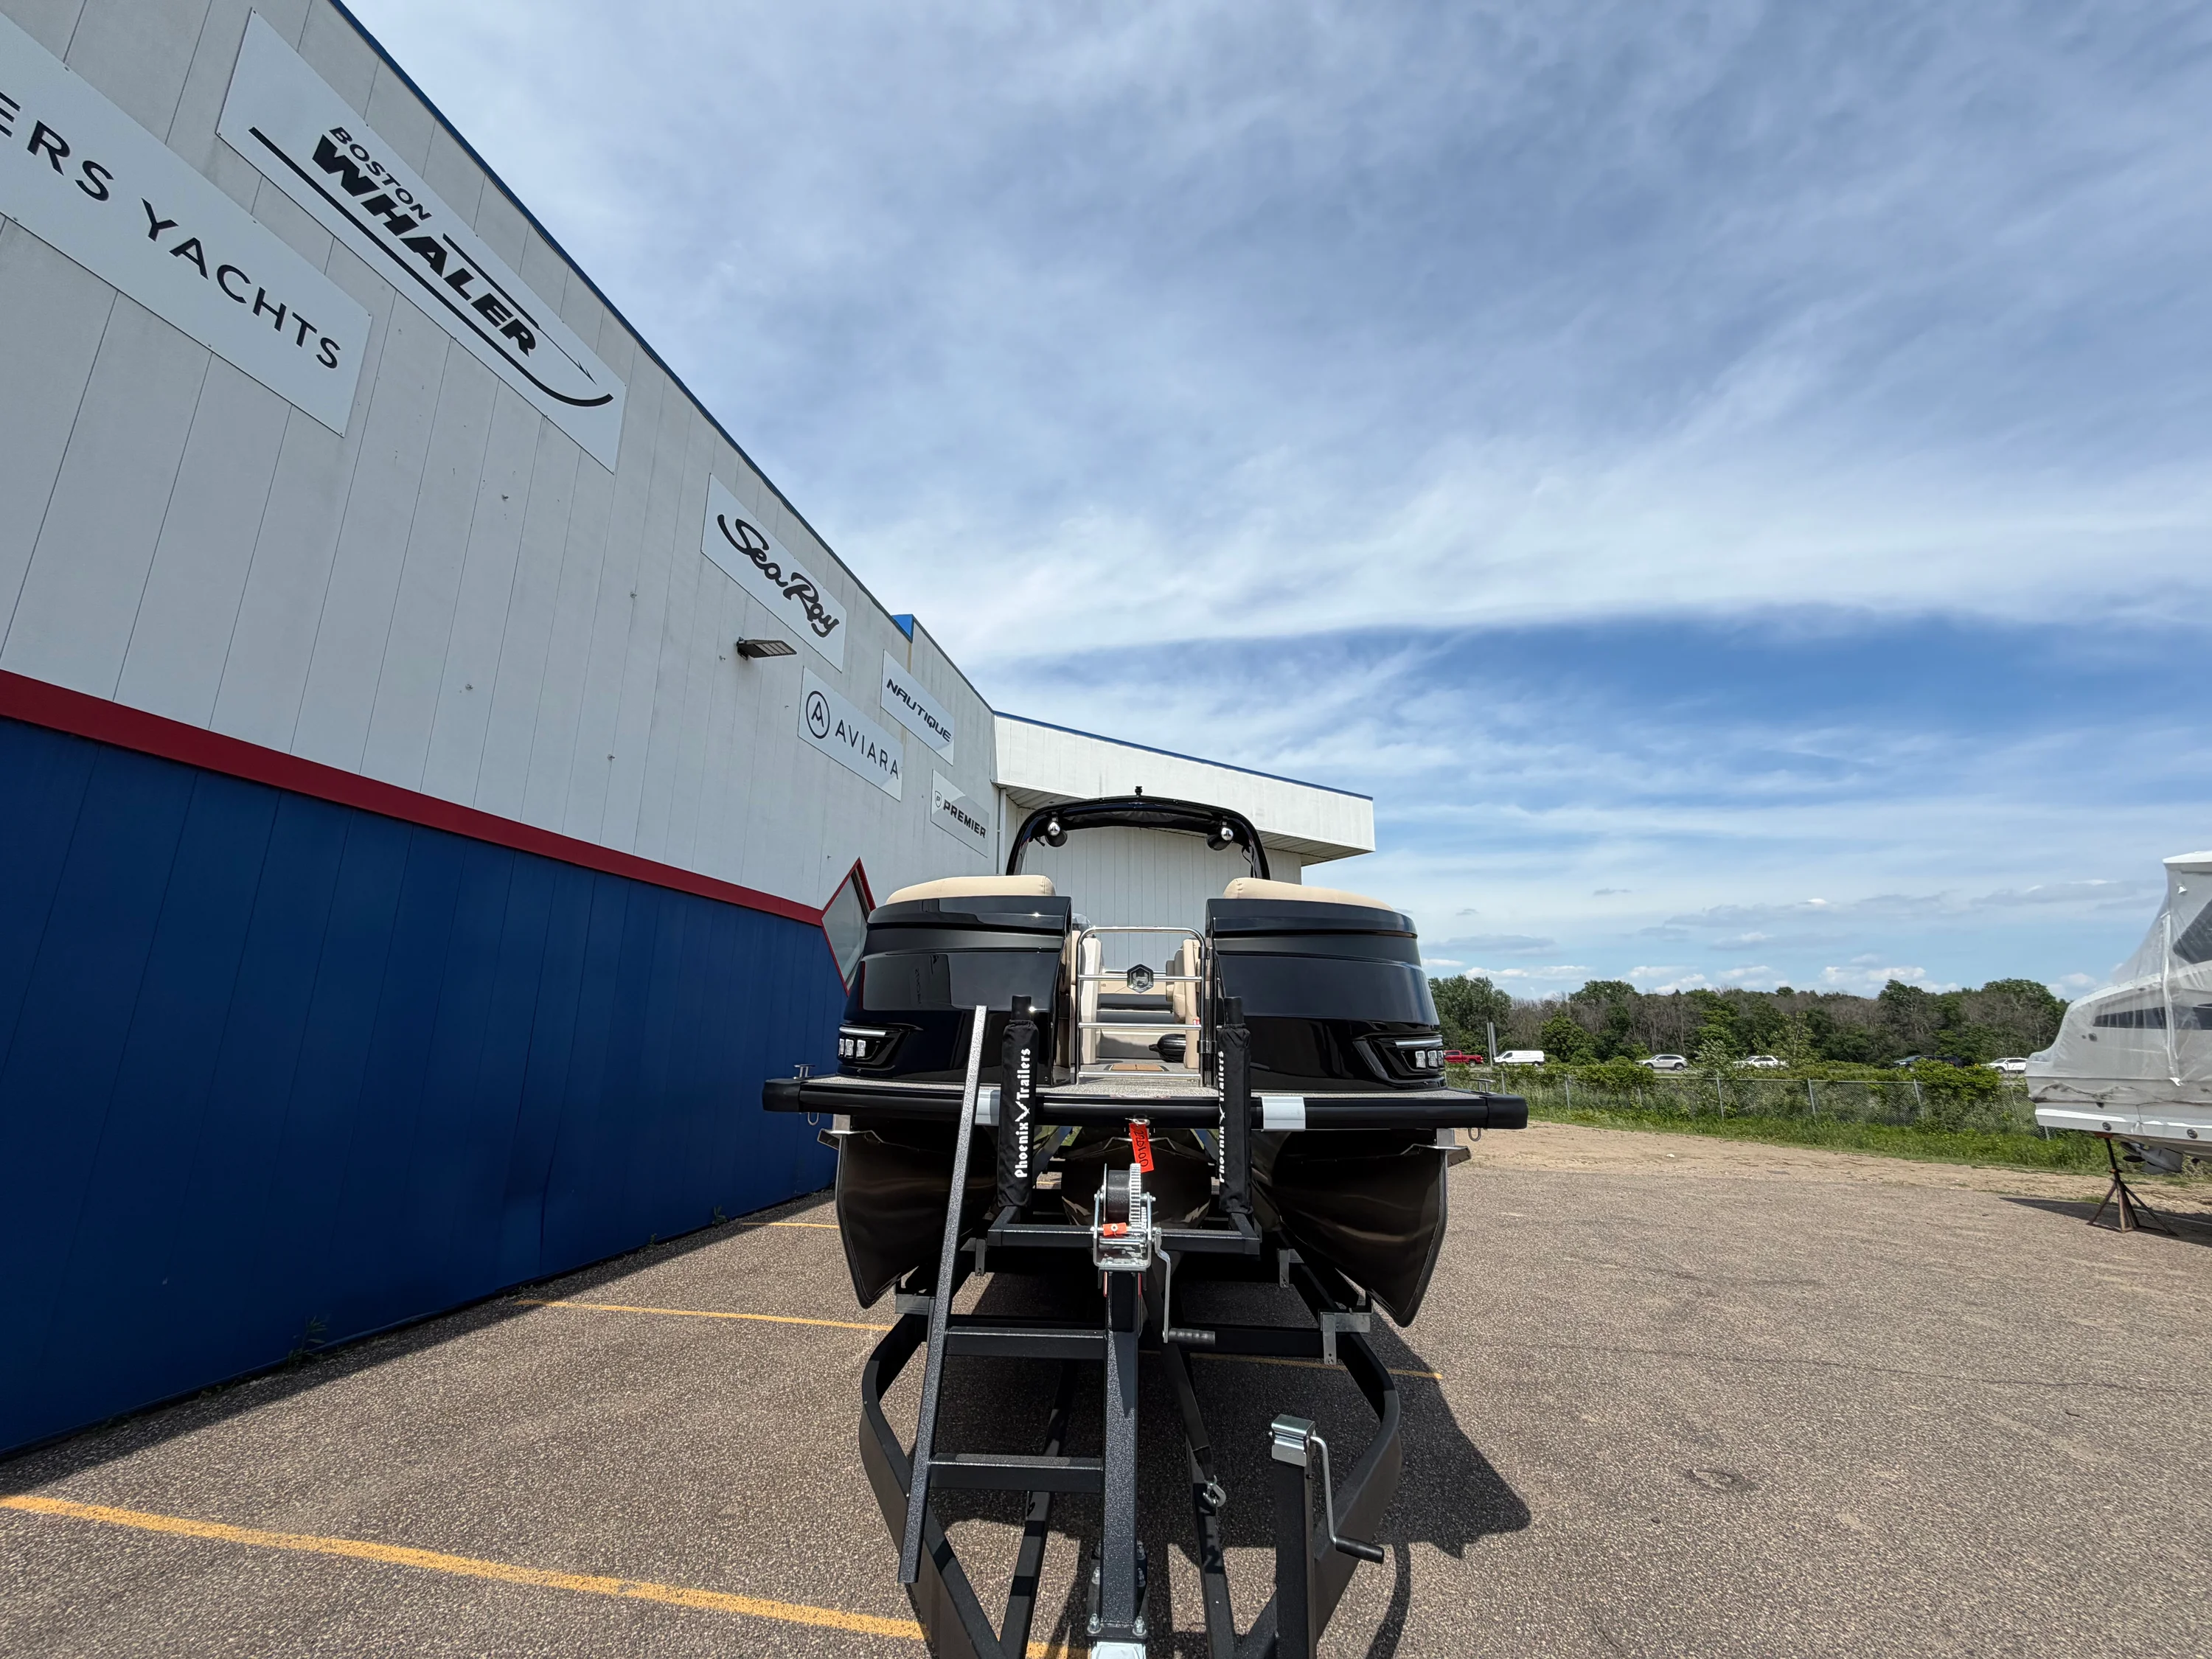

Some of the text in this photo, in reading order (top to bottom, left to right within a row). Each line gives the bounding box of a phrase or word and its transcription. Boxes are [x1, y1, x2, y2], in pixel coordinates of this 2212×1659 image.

[328, 126, 433, 221] BOSTON
[141, 197, 341, 369] YACHTS
[311, 133, 537, 358] WHALER
[717, 513, 841, 639] Sea Ray
[835, 719, 899, 780] AVIARA
[886, 678, 952, 742] NAUTIQUE
[943, 799, 987, 839] PREMIER
[1014, 1048, 1031, 1178] Phoenix Trailers
